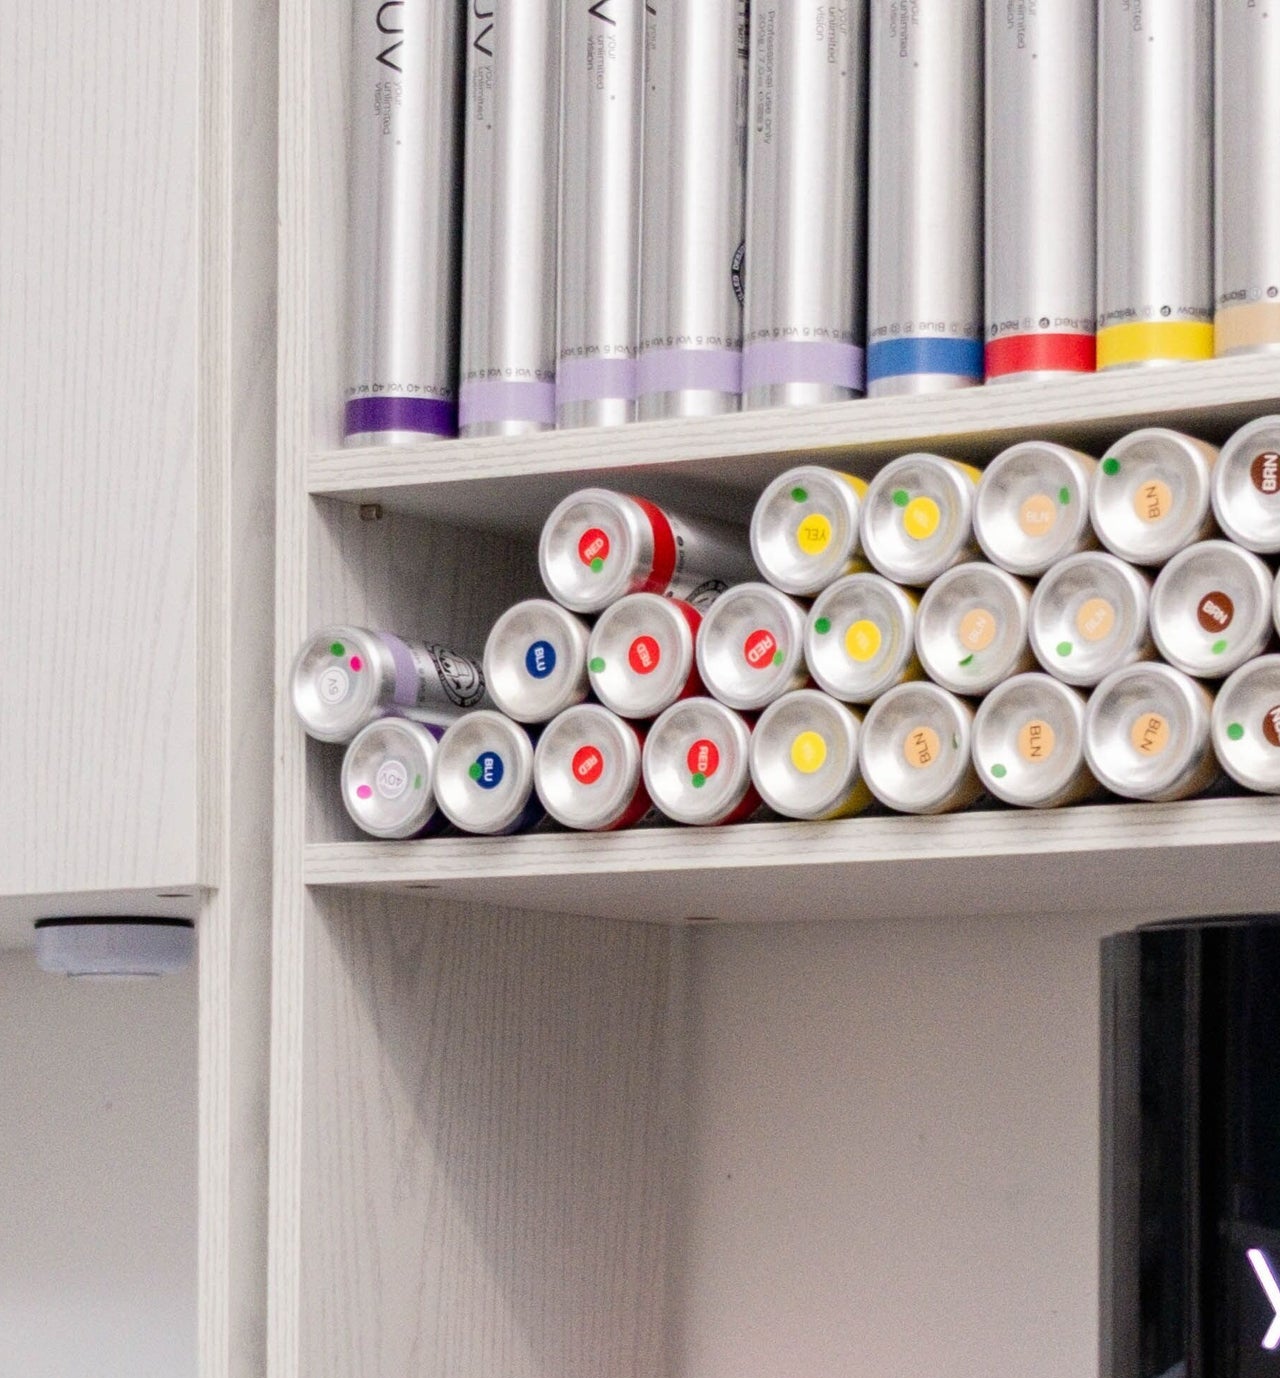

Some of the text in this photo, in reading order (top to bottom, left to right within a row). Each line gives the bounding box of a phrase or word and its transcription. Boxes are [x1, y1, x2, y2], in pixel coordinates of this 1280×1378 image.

[919, 321, 946, 332] Blue
[1054, 318, 1078, 328] Red
[1263, 454, 1278, 492] BRN
[1145, 485, 1161, 519] BLN
[584, 537, 605, 559] RED
[803, 528, 827, 543] YEL
[1202, 600, 1229, 623] BRN
[534, 647, 546, 672] BLU
[636, 643, 653, 668] RED
[748, 635, 774, 663] RED
[1030, 725, 1042, 758] BLN
[1141, 717, 1161, 752] BLN
[697, 745, 709, 772] RED
[913, 732, 930, 765] BLN
[484, 758, 494, 782] BLU
[578, 755, 598, 776] RED
